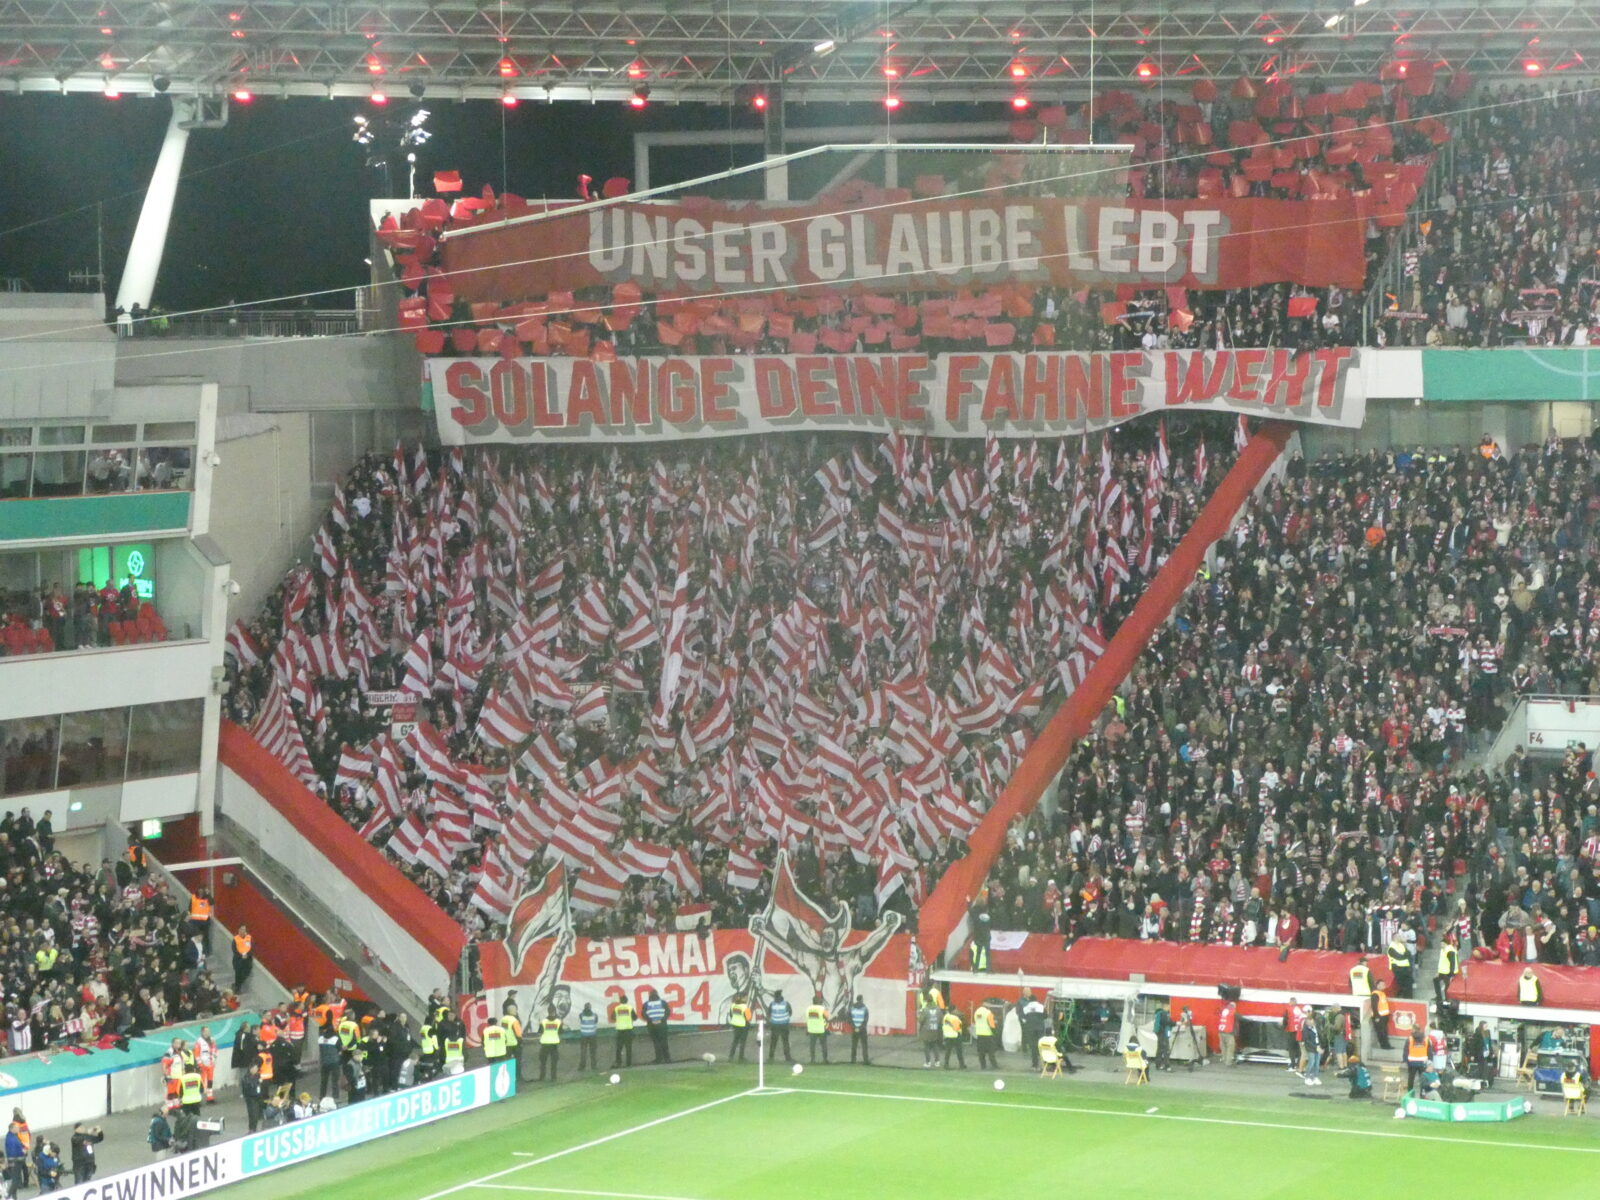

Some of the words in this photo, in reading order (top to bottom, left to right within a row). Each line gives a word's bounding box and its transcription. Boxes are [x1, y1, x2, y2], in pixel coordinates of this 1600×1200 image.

[588, 206, 788, 284] UNSER
[807, 206, 1039, 282] GLAUBE
[1065, 206, 1221, 274] LEBT
[446, 358, 738, 429] SOLANGE
[754, 356, 930, 422] DEINE
[945, 350, 1144, 421] FAHNE
[1165, 348, 1357, 409] WEHT
[1529, 732, 1544, 744] F4
[587, 929, 717, 979] 25.MAI
[604, 981, 711, 1023] 2024
[252, 1080, 462, 1167] FUSSBALLZEIT.DFB.DE
